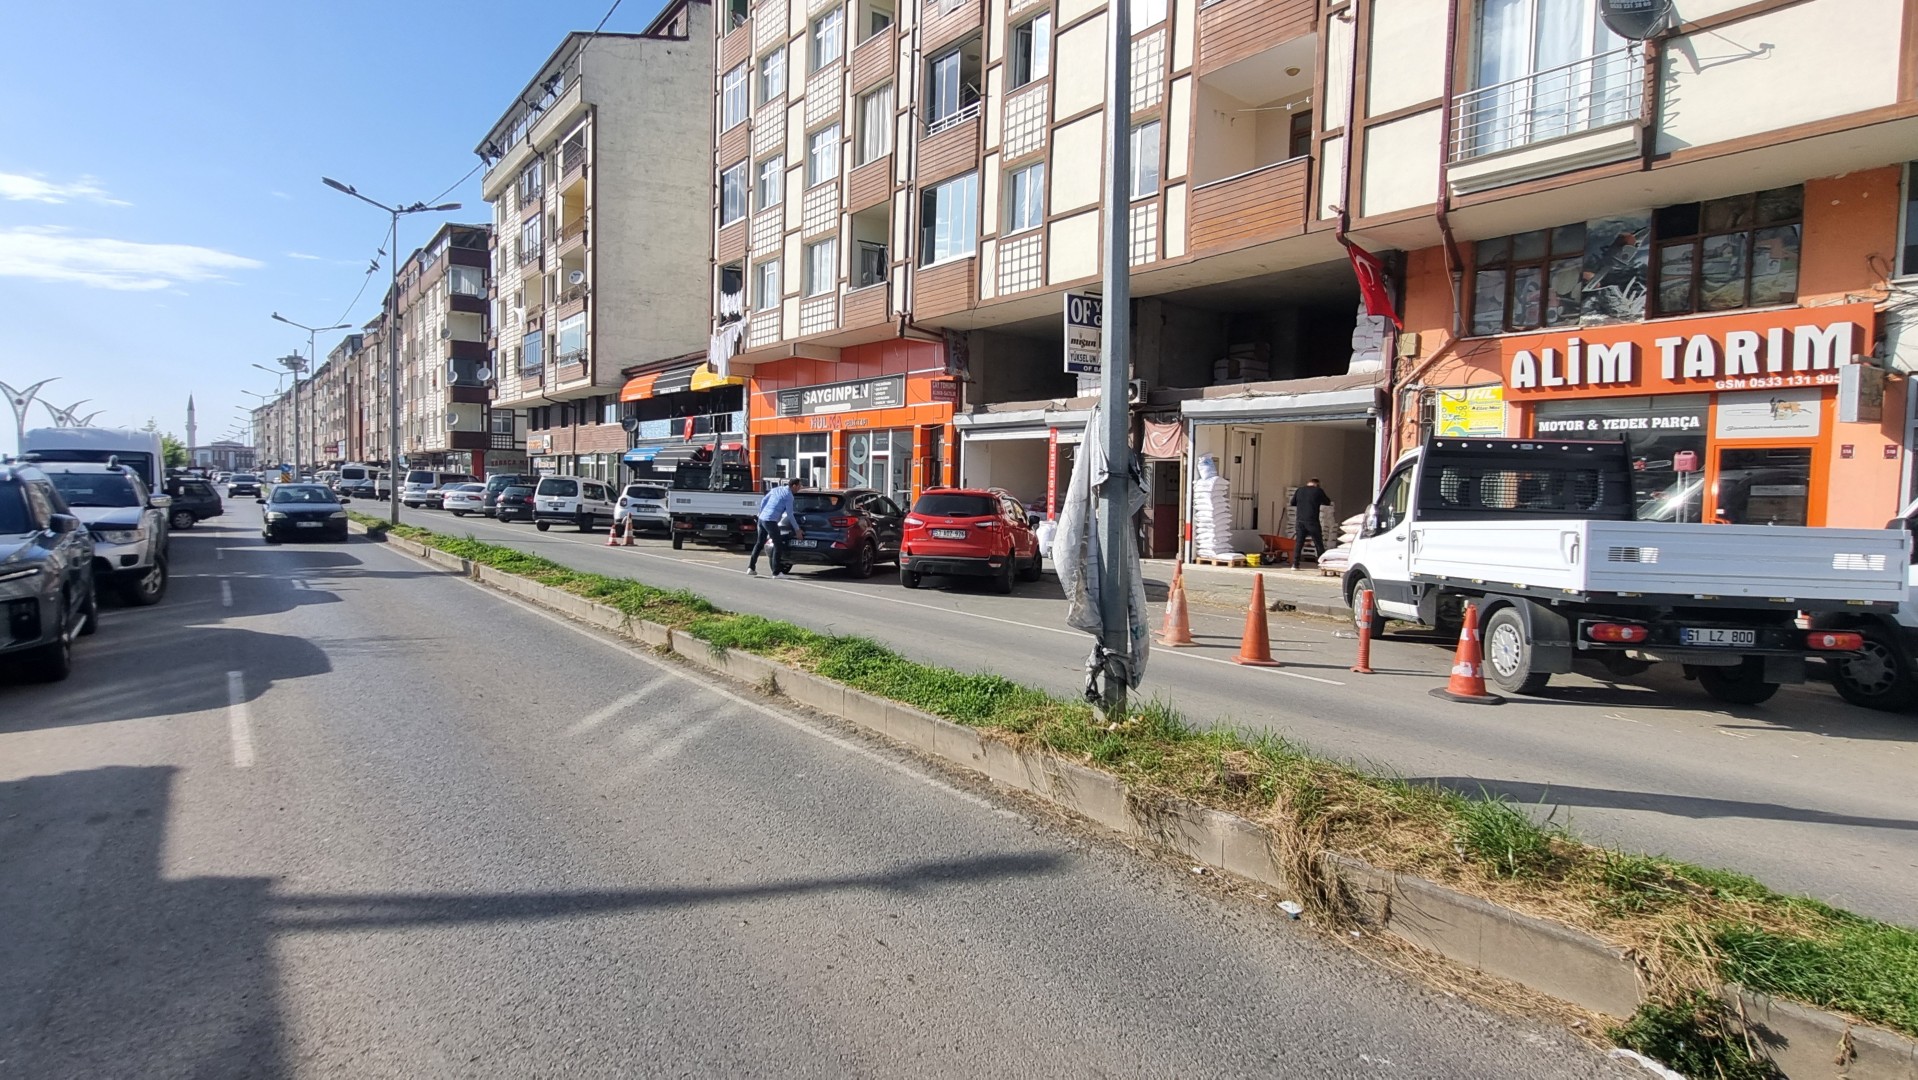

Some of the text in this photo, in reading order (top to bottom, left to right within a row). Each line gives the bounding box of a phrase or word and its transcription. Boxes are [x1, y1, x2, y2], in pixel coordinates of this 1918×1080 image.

[1070, 297, 1092, 324] OF
[1510, 322, 1853, 388] ALİM TARIM
[1715, 374, 1840, 389] GSM 0533 131 905
[803, 383, 869, 405] SAYGINPEN
[1538, 416, 1700, 432] MOTOR & YEDEK PARÇA
[1709, 630, 1724, 642] LZ
[1731, 631, 1753, 643] 800
